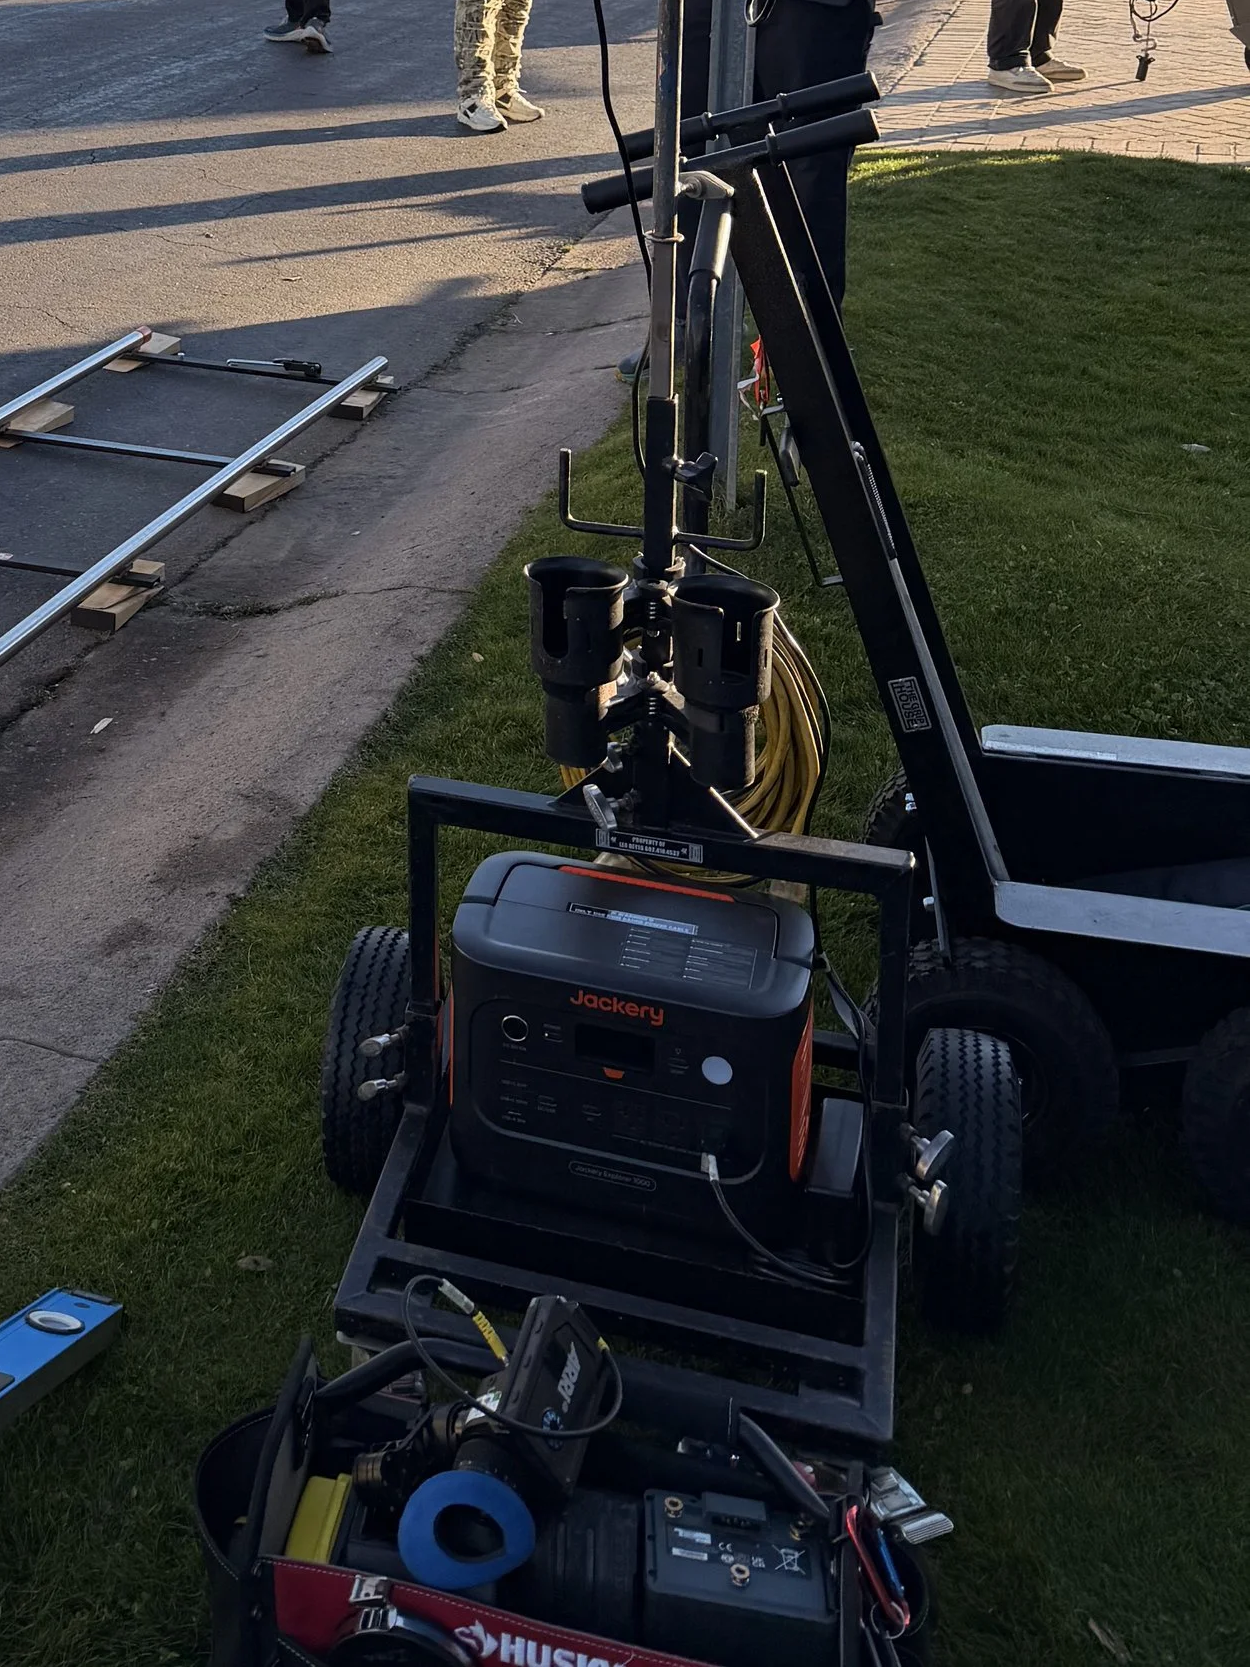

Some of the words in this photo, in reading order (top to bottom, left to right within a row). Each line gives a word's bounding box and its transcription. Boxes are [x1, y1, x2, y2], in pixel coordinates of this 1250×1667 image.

[894, 684, 918, 727] HOUSE
[905, 681, 917, 702] THE
[911, 702, 925, 725] GRIP
[569, 989, 664, 1026] Jackery
[557, 1341, 582, 1404] ARRI
